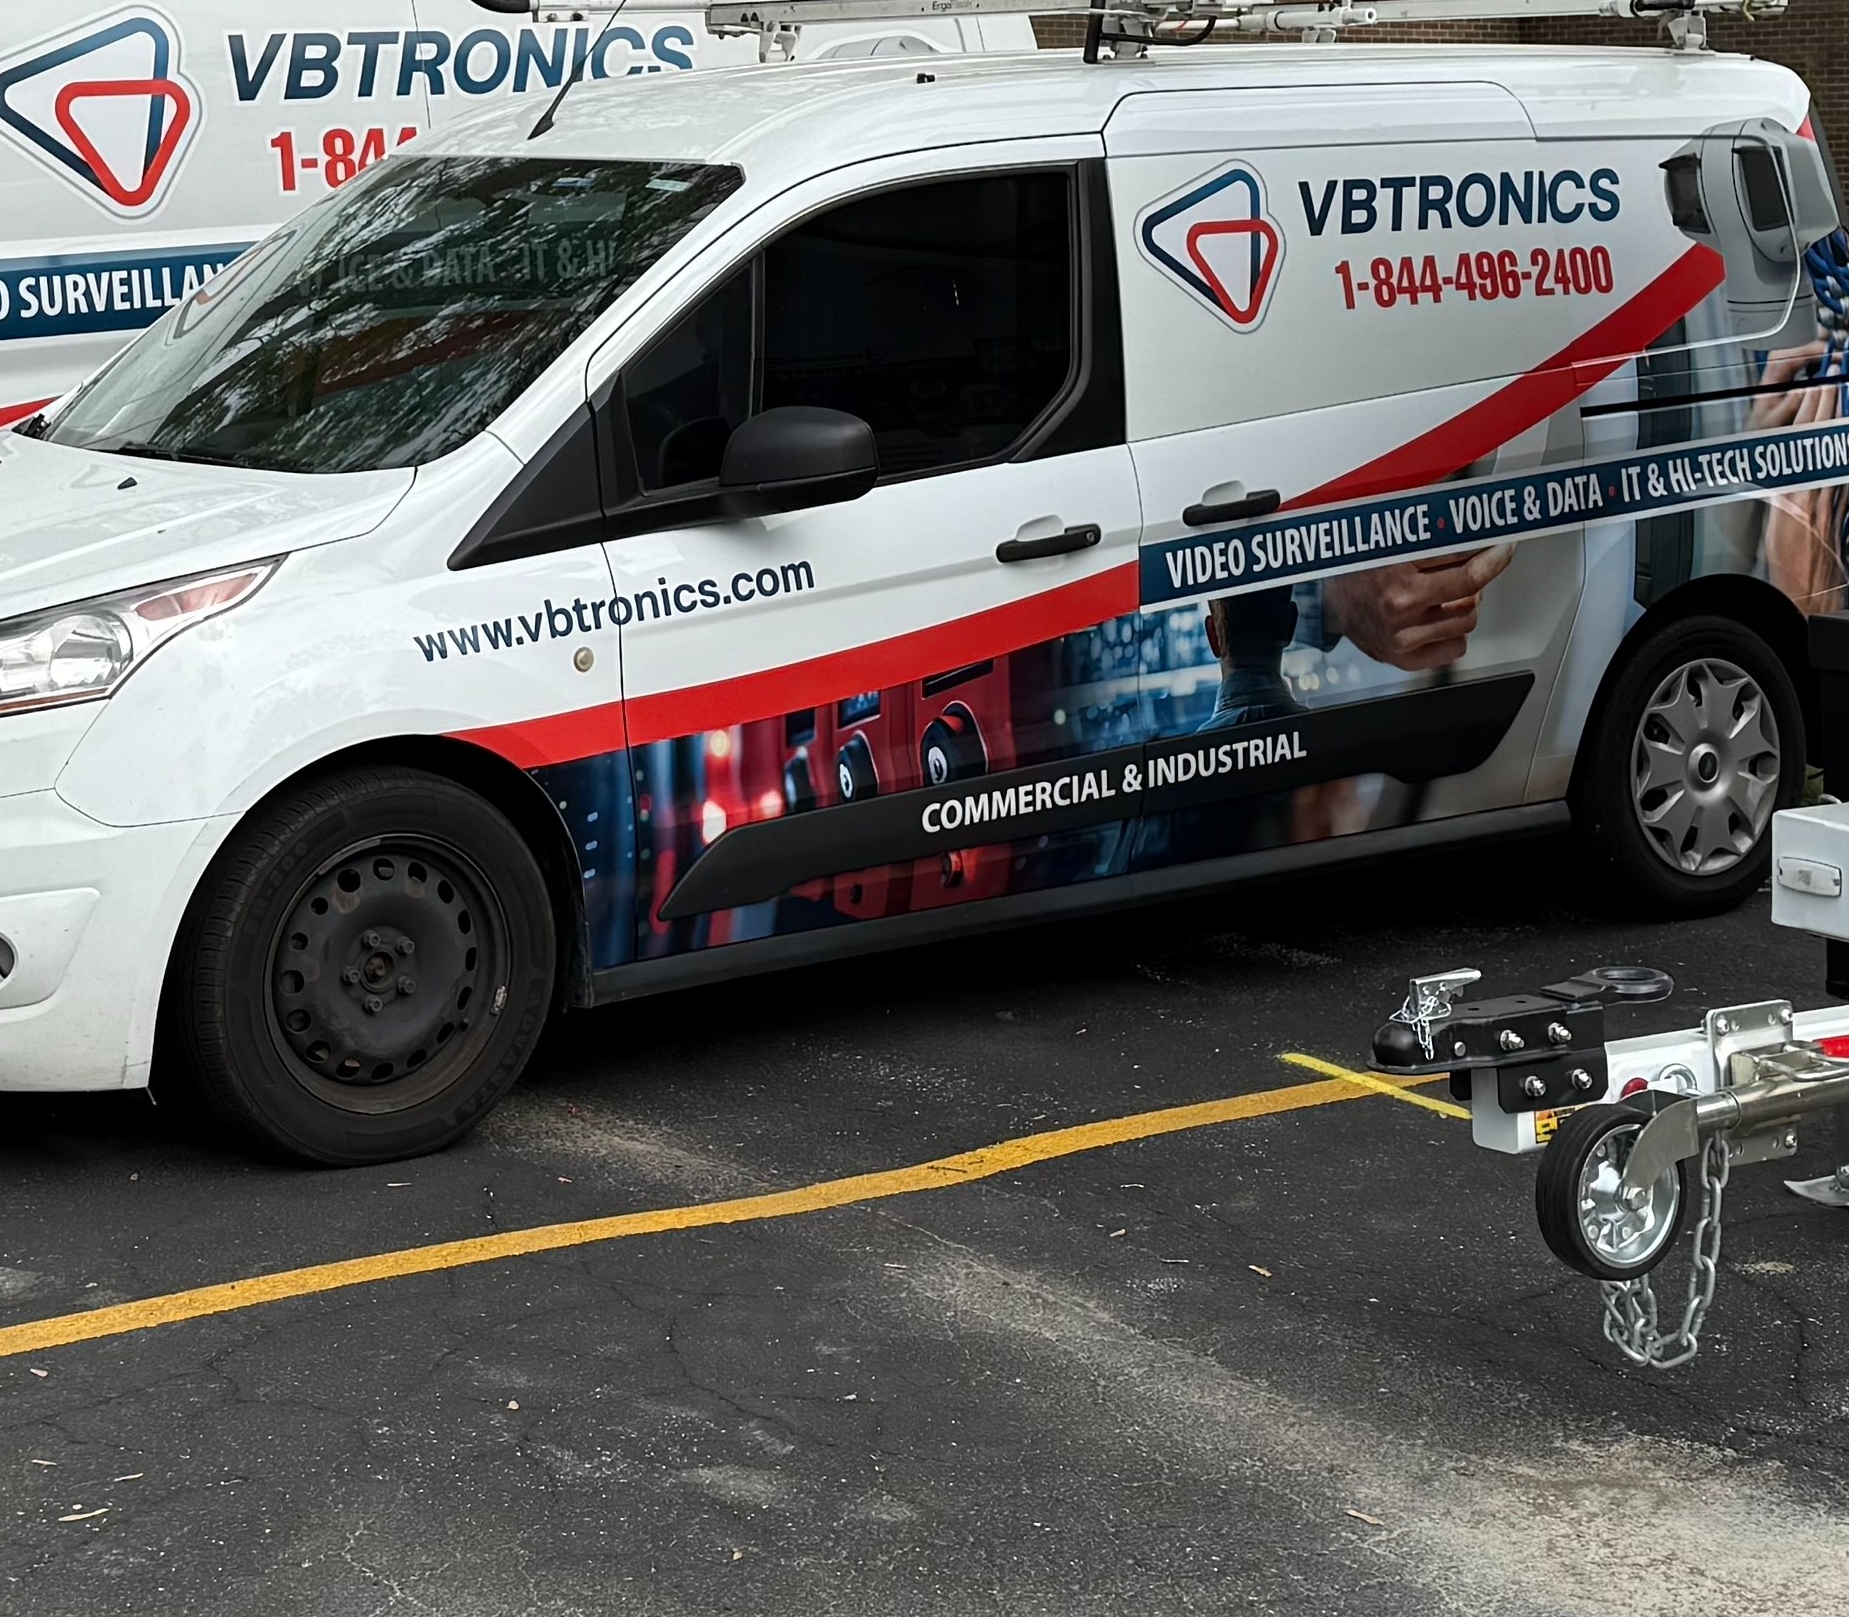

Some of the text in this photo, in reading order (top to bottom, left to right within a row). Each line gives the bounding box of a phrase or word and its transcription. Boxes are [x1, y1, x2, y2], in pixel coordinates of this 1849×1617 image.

[227, 26, 696, 102] VBTRONICS
[271, 126, 418, 195] 1-84
[1298, 169, 1620, 237] VBTRONICS
[1335, 245, 1615, 310] 1-844-496-2400
[1166, 539, 1245, 589] VIDEO
[1251, 512, 1431, 573] SURVEILLANCE
[1449, 493, 1518, 535] VOICE
[1523, 489, 1541, 519] &
[1548, 474, 1604, 517] DATA
[1621, 466, 1642, 502] IT
[1646, 461, 1667, 497] &
[1670, 444, 1752, 493] HI-TECH
[414, 559, 815, 663] www.vbtronics.com
[921, 731, 1307, 835] COMMERCIAL & INDUSTRIAL
